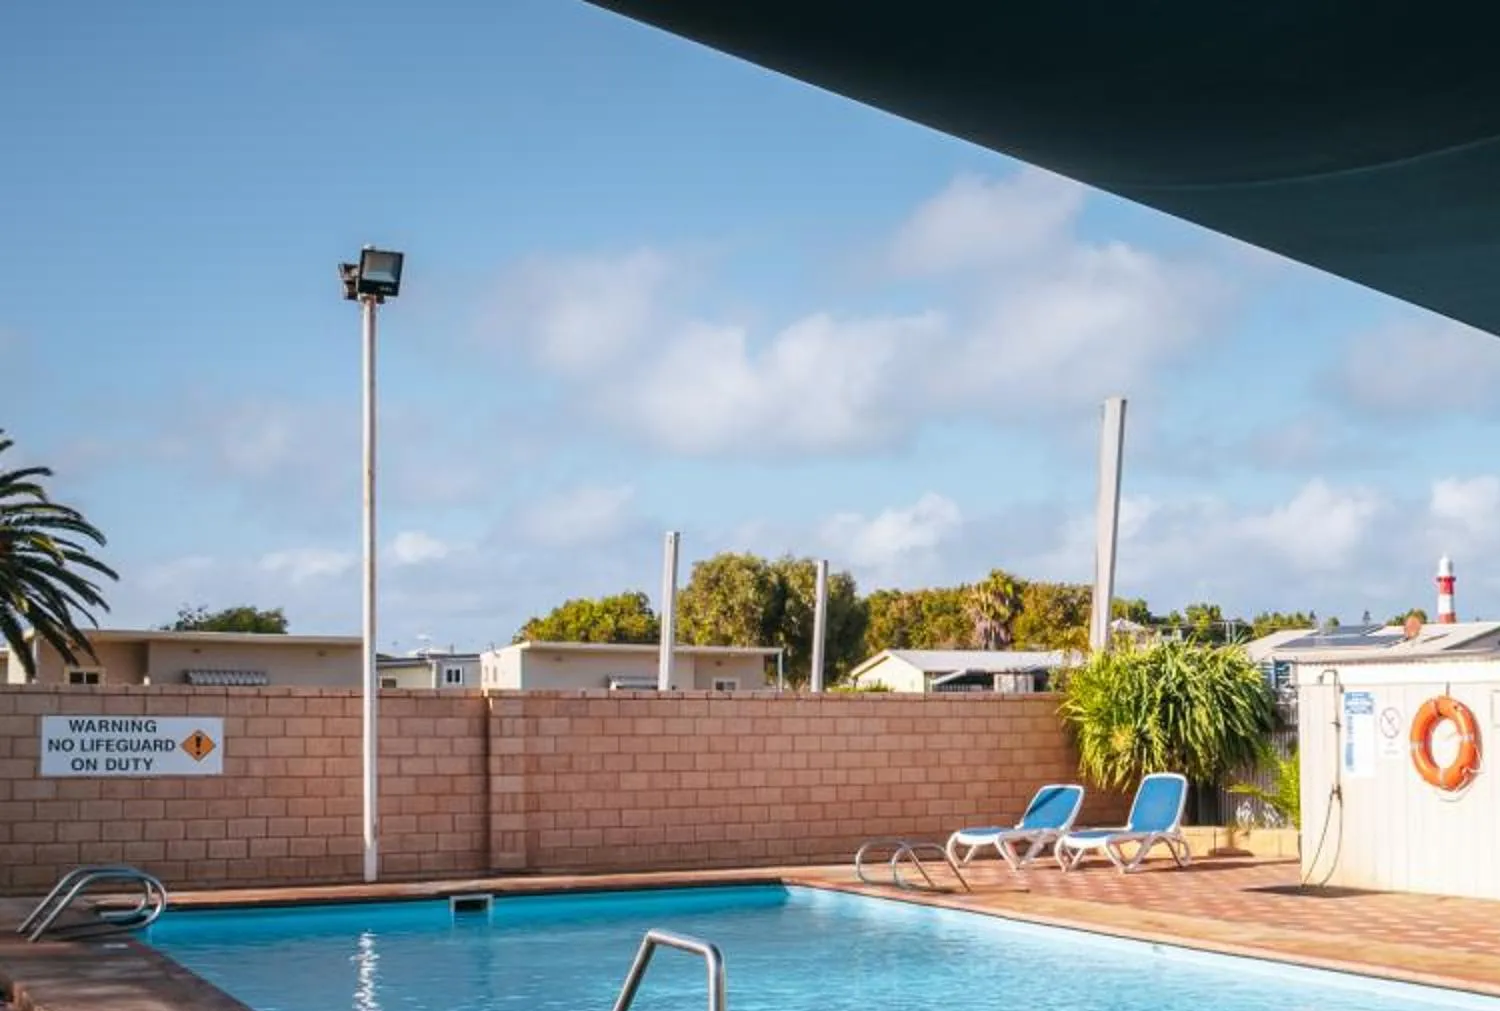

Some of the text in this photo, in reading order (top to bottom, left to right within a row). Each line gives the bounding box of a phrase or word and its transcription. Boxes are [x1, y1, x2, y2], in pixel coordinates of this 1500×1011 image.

[69, 719, 157, 733] WARNING
[48, 739, 176, 753] NO LIFEGUARD
[71, 758, 153, 771] ON DUTY
